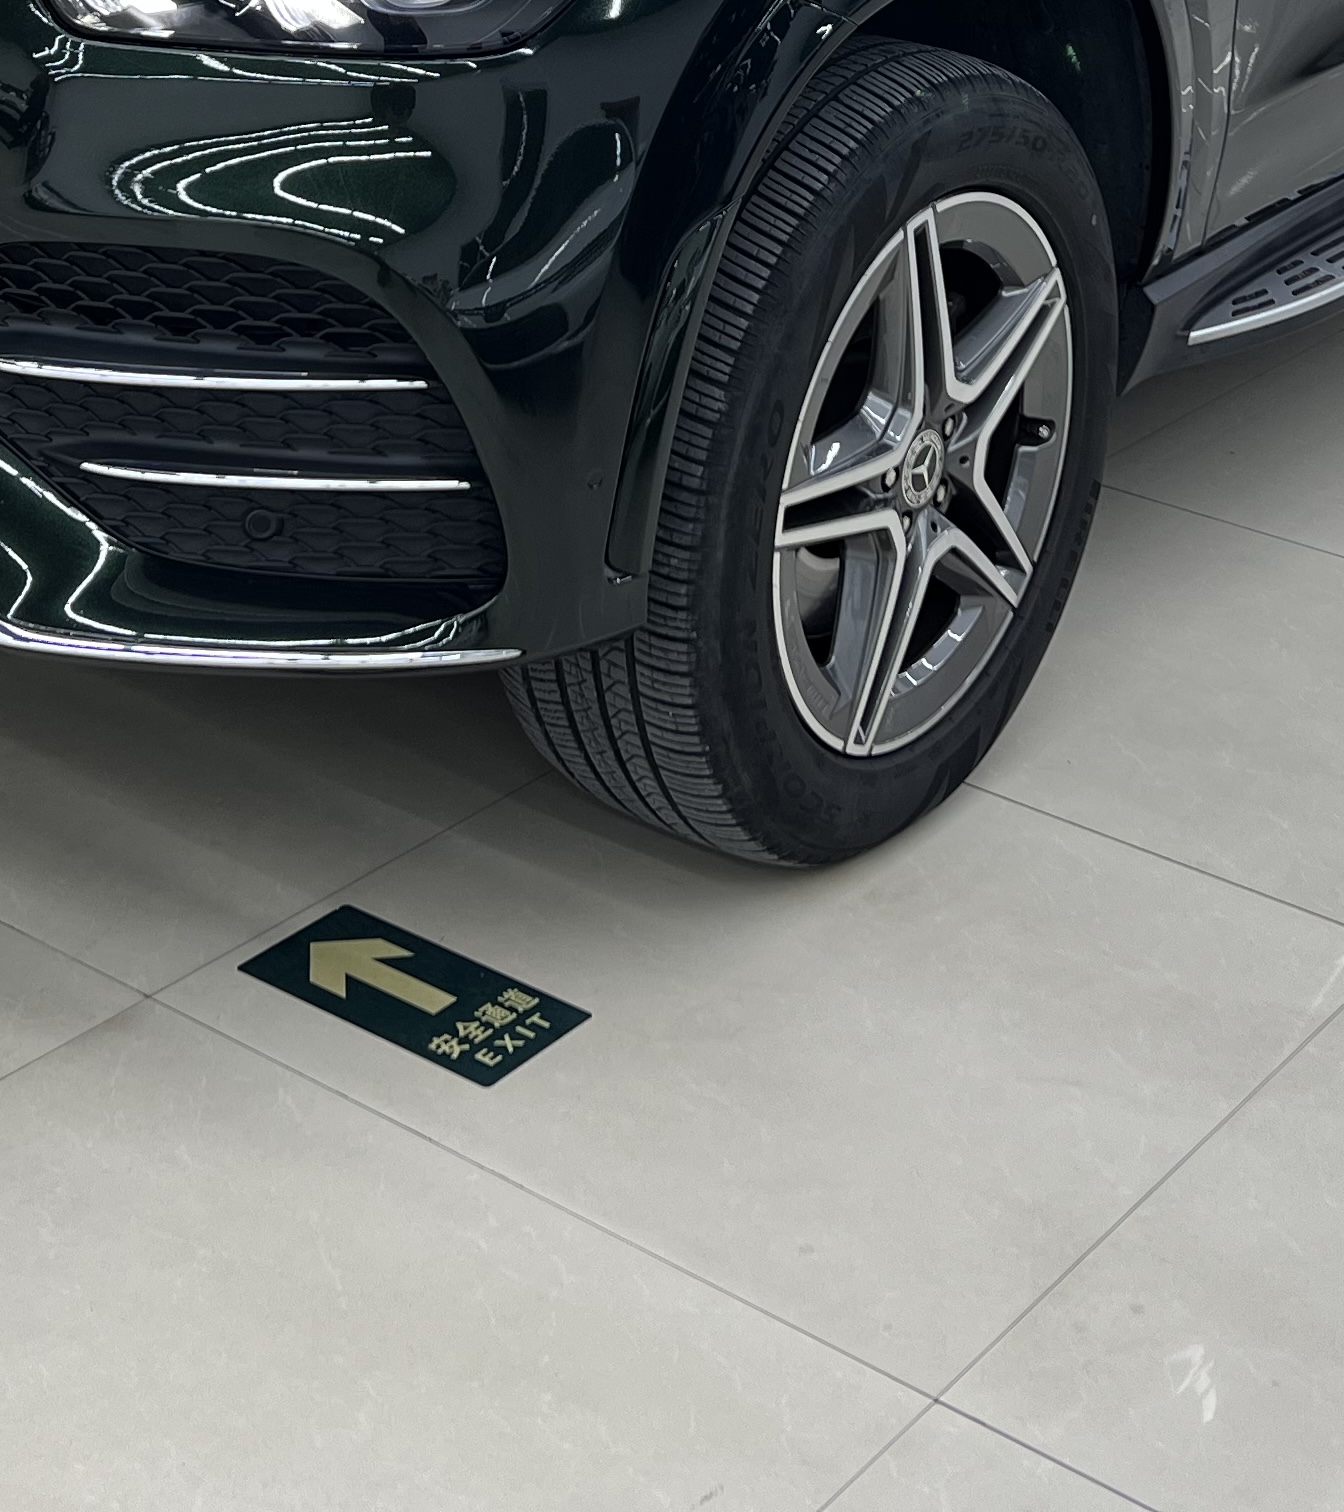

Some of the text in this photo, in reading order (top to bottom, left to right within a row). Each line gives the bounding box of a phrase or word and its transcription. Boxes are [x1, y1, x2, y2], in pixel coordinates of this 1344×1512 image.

[428, 988, 539, 1060] 安全通道
[474, 1012, 551, 1067] EXIT
